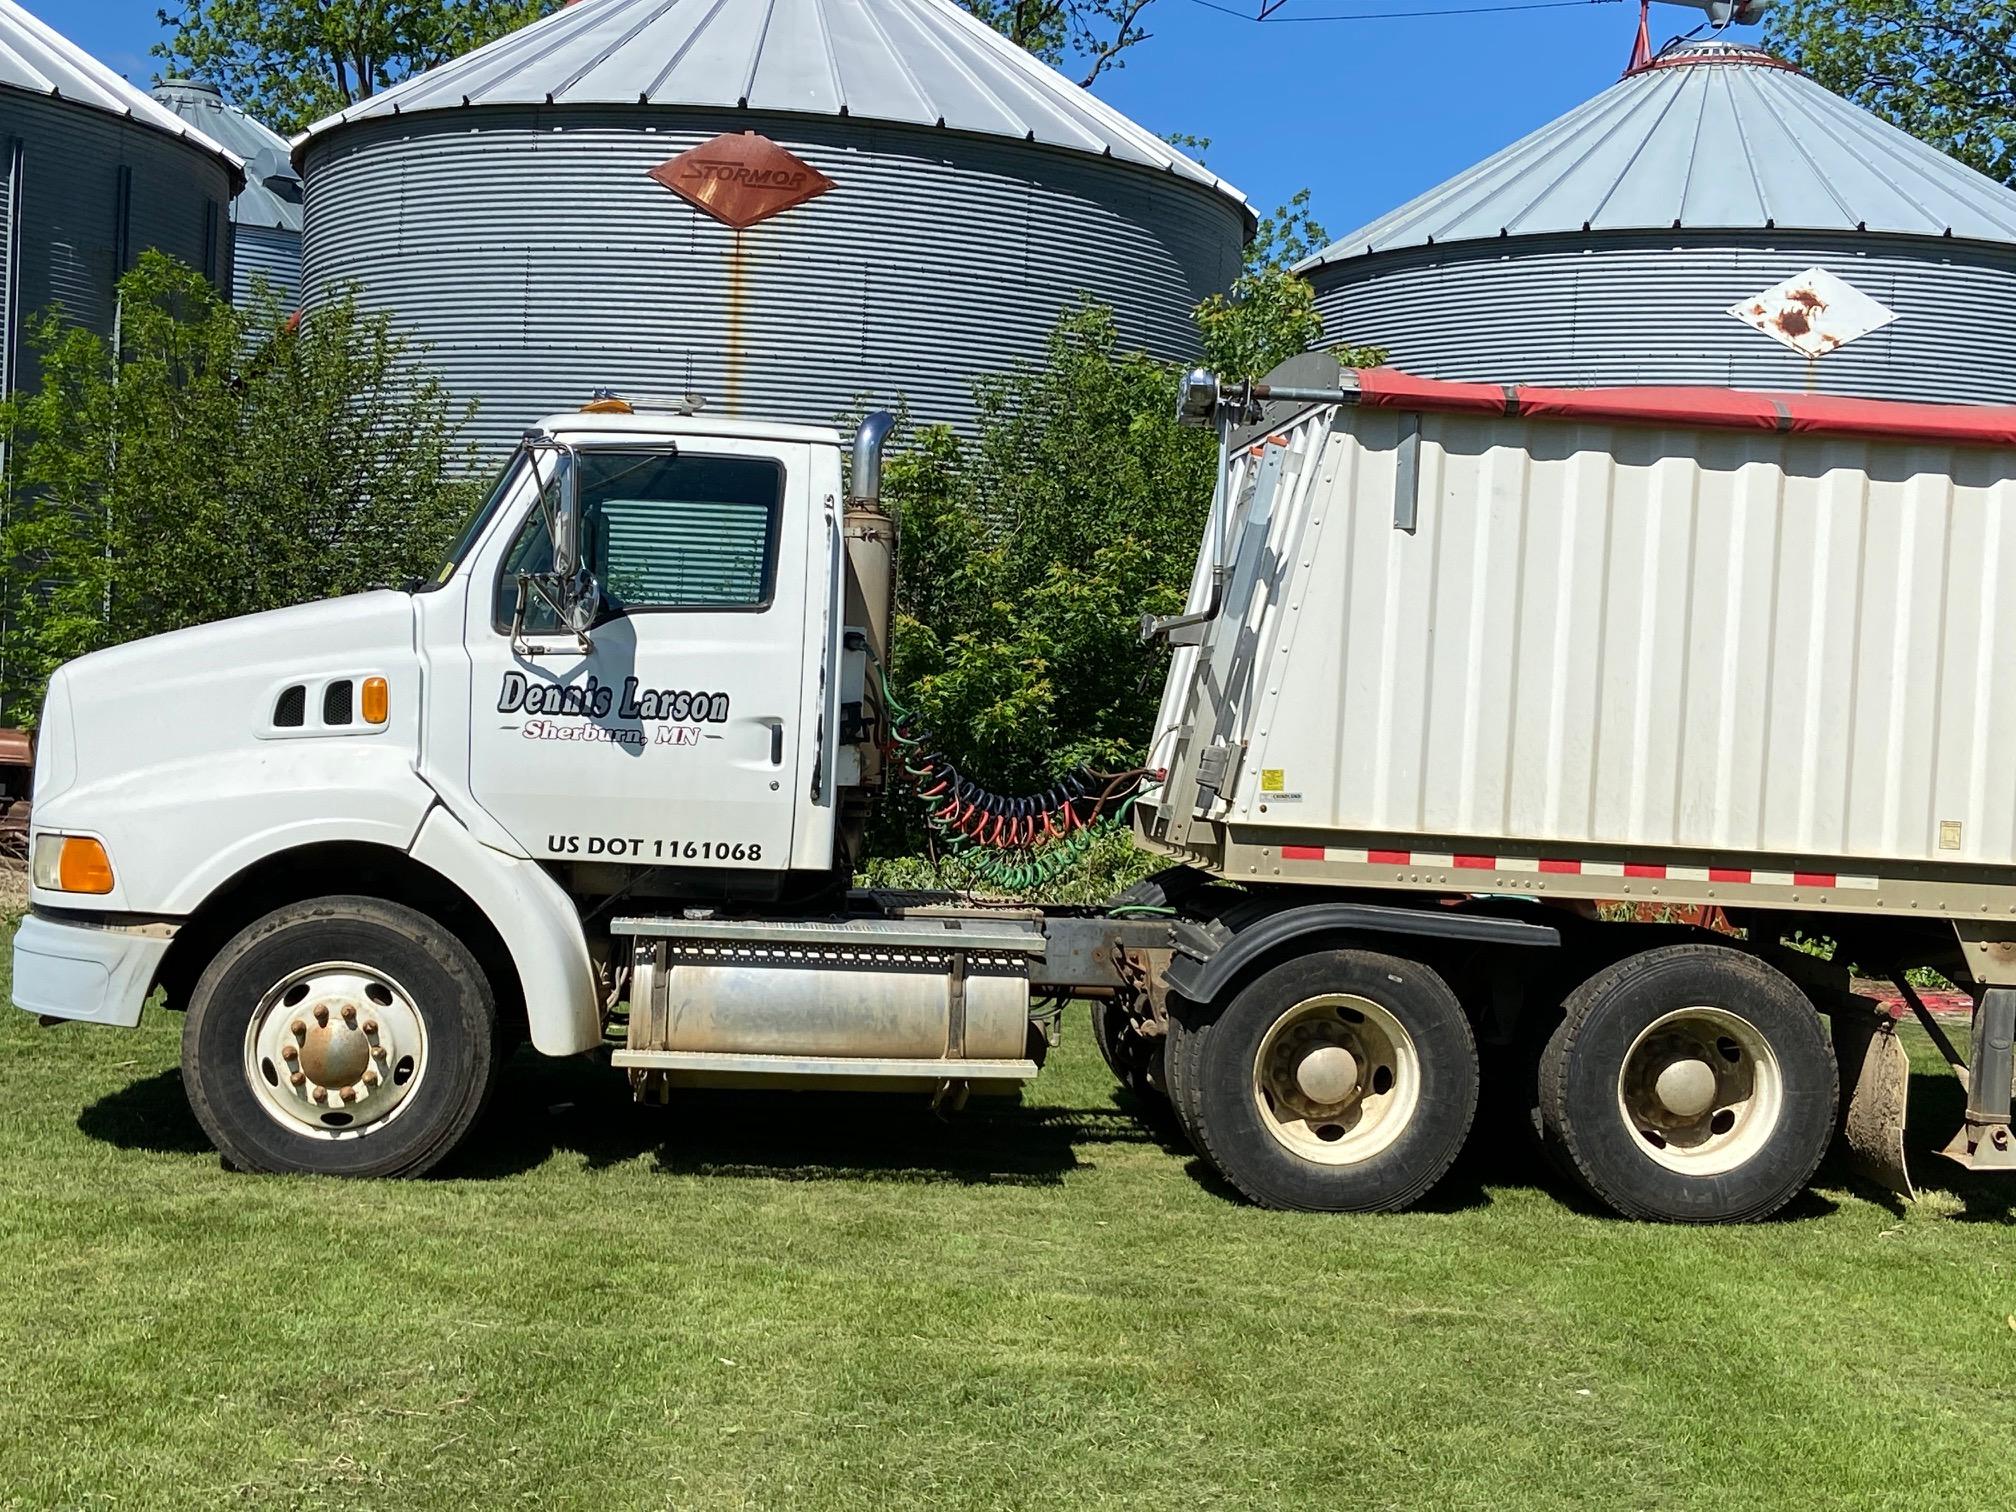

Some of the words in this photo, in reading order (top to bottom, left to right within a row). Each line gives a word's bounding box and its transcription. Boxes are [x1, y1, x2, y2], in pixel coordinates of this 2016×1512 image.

[681, 159, 807, 191] STORMOR
[497, 671, 612, 718] Dennis
[619, 677, 730, 723] Larson
[523, 720, 647, 746] Sherburn,
[654, 725, 702, 746] MN
[548, 835, 579, 853] US
[588, 837, 644, 856] DOT
[653, 839, 762, 861] 1161068
